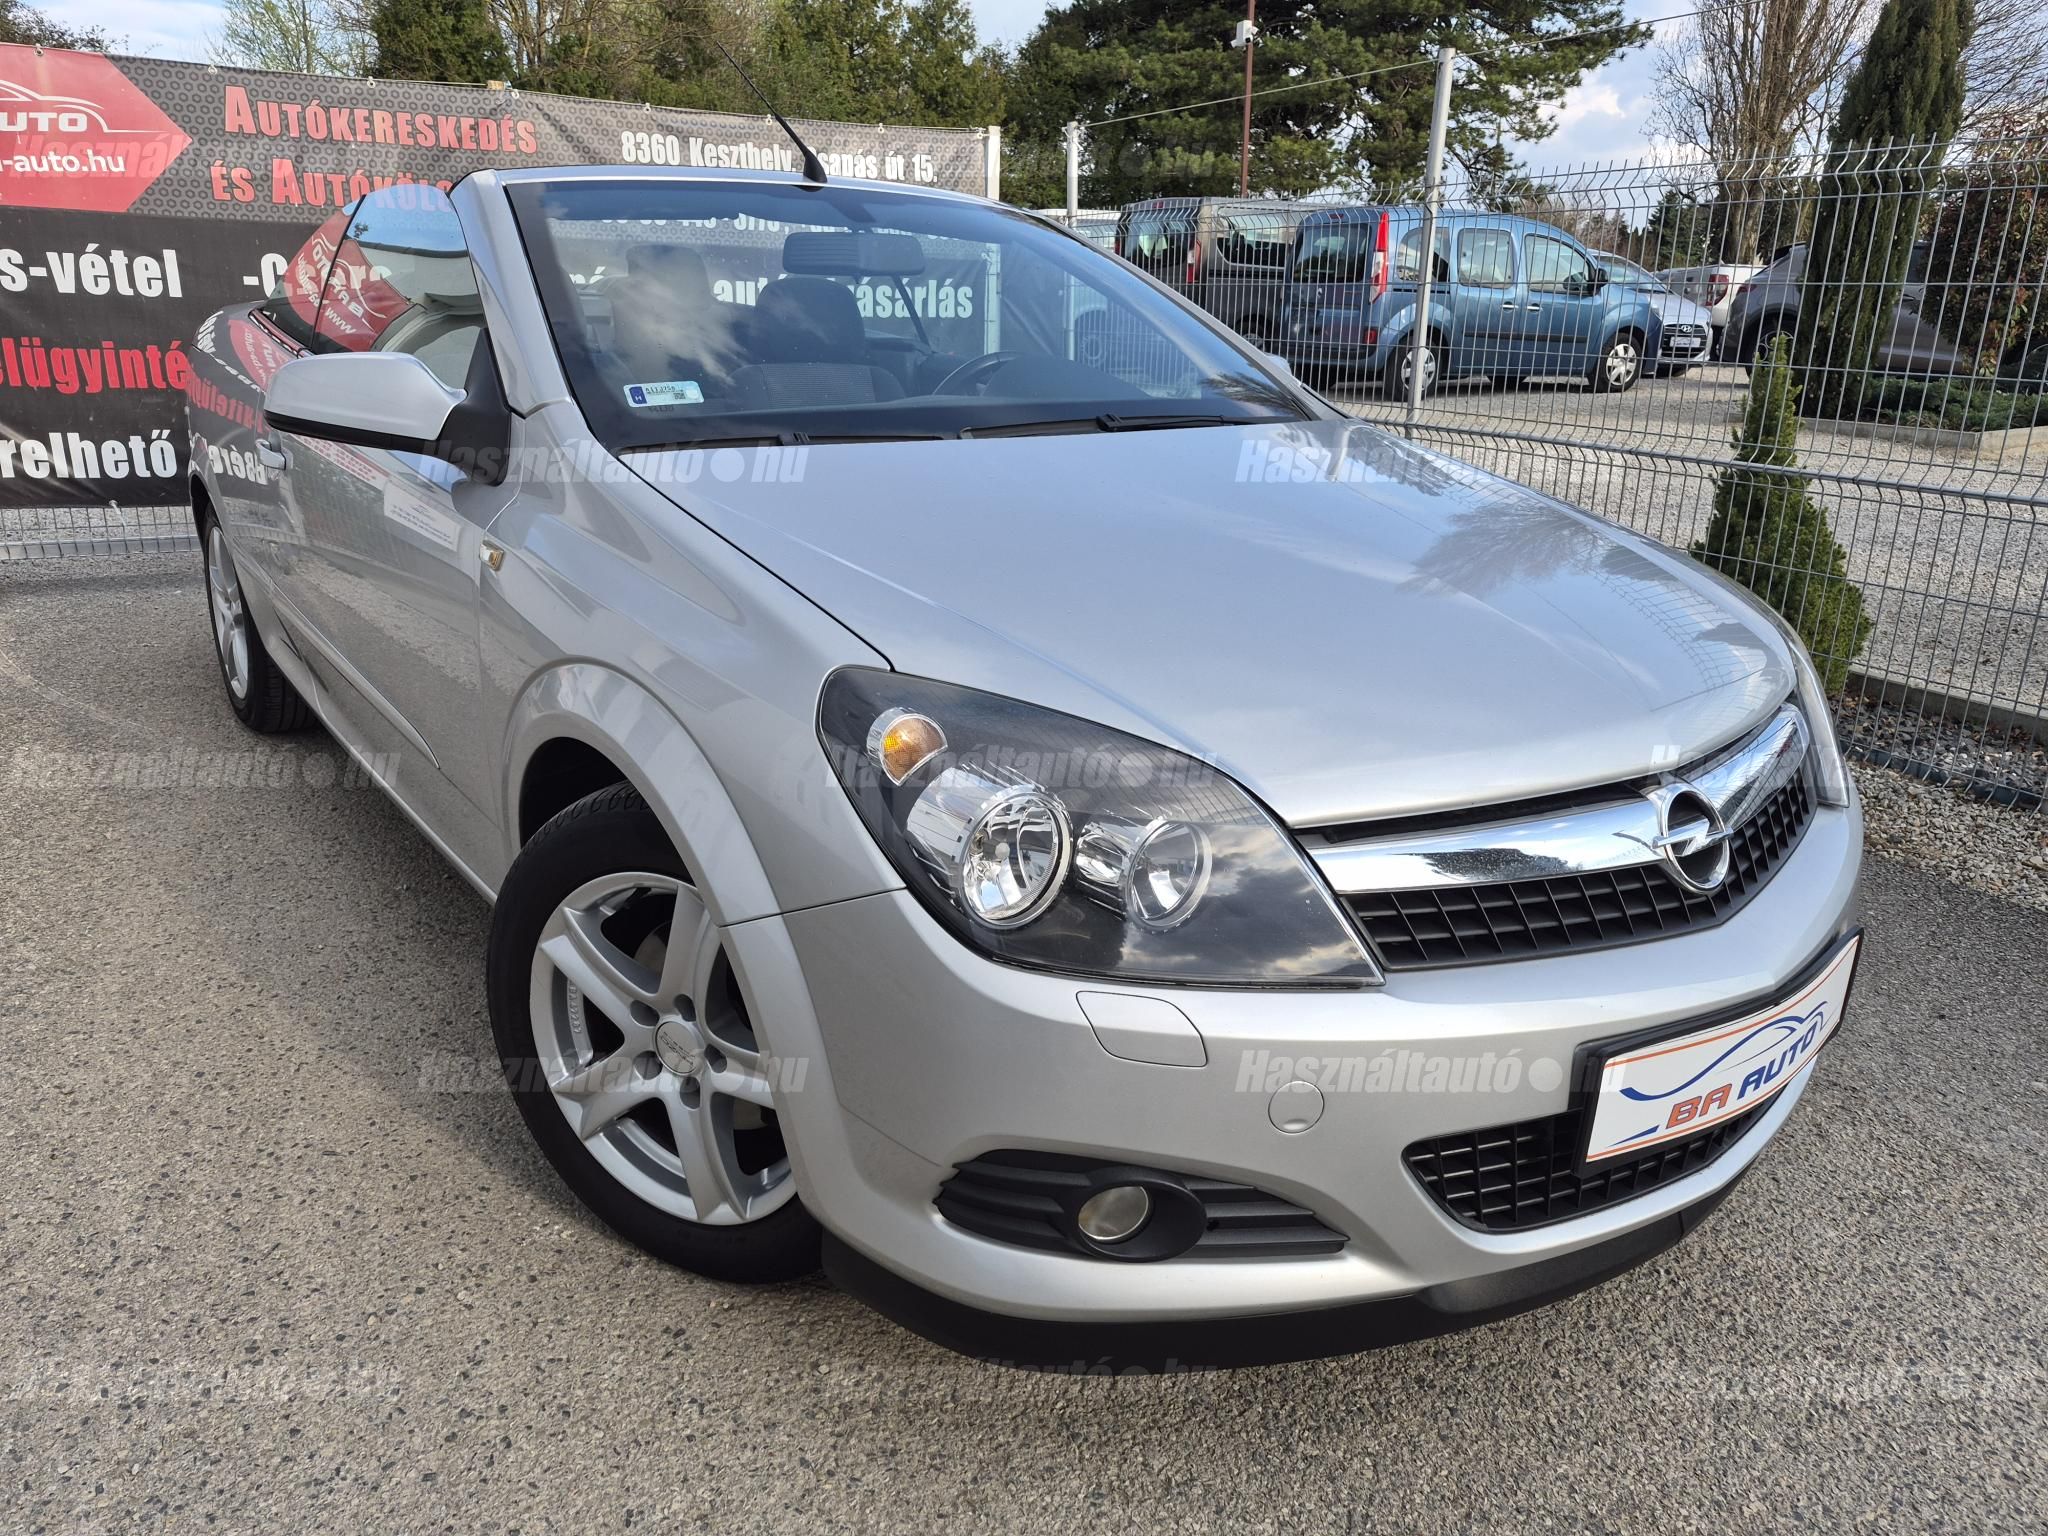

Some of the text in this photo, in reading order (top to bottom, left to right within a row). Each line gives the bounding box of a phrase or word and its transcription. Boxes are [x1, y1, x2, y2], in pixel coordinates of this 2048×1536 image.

[0, 149, 126, 173] -auto.hu
[210, 160, 256, 202] ÉS
[621, 131, 681, 166] 8360
[806, 147, 878, 180] sapás
[885, 149, 906, 181] út
[912, 153, 938, 183] 15.
[0, 337, 192, 395] lügyinté
[1665, 1020, 1818, 1129] BA AUTO
